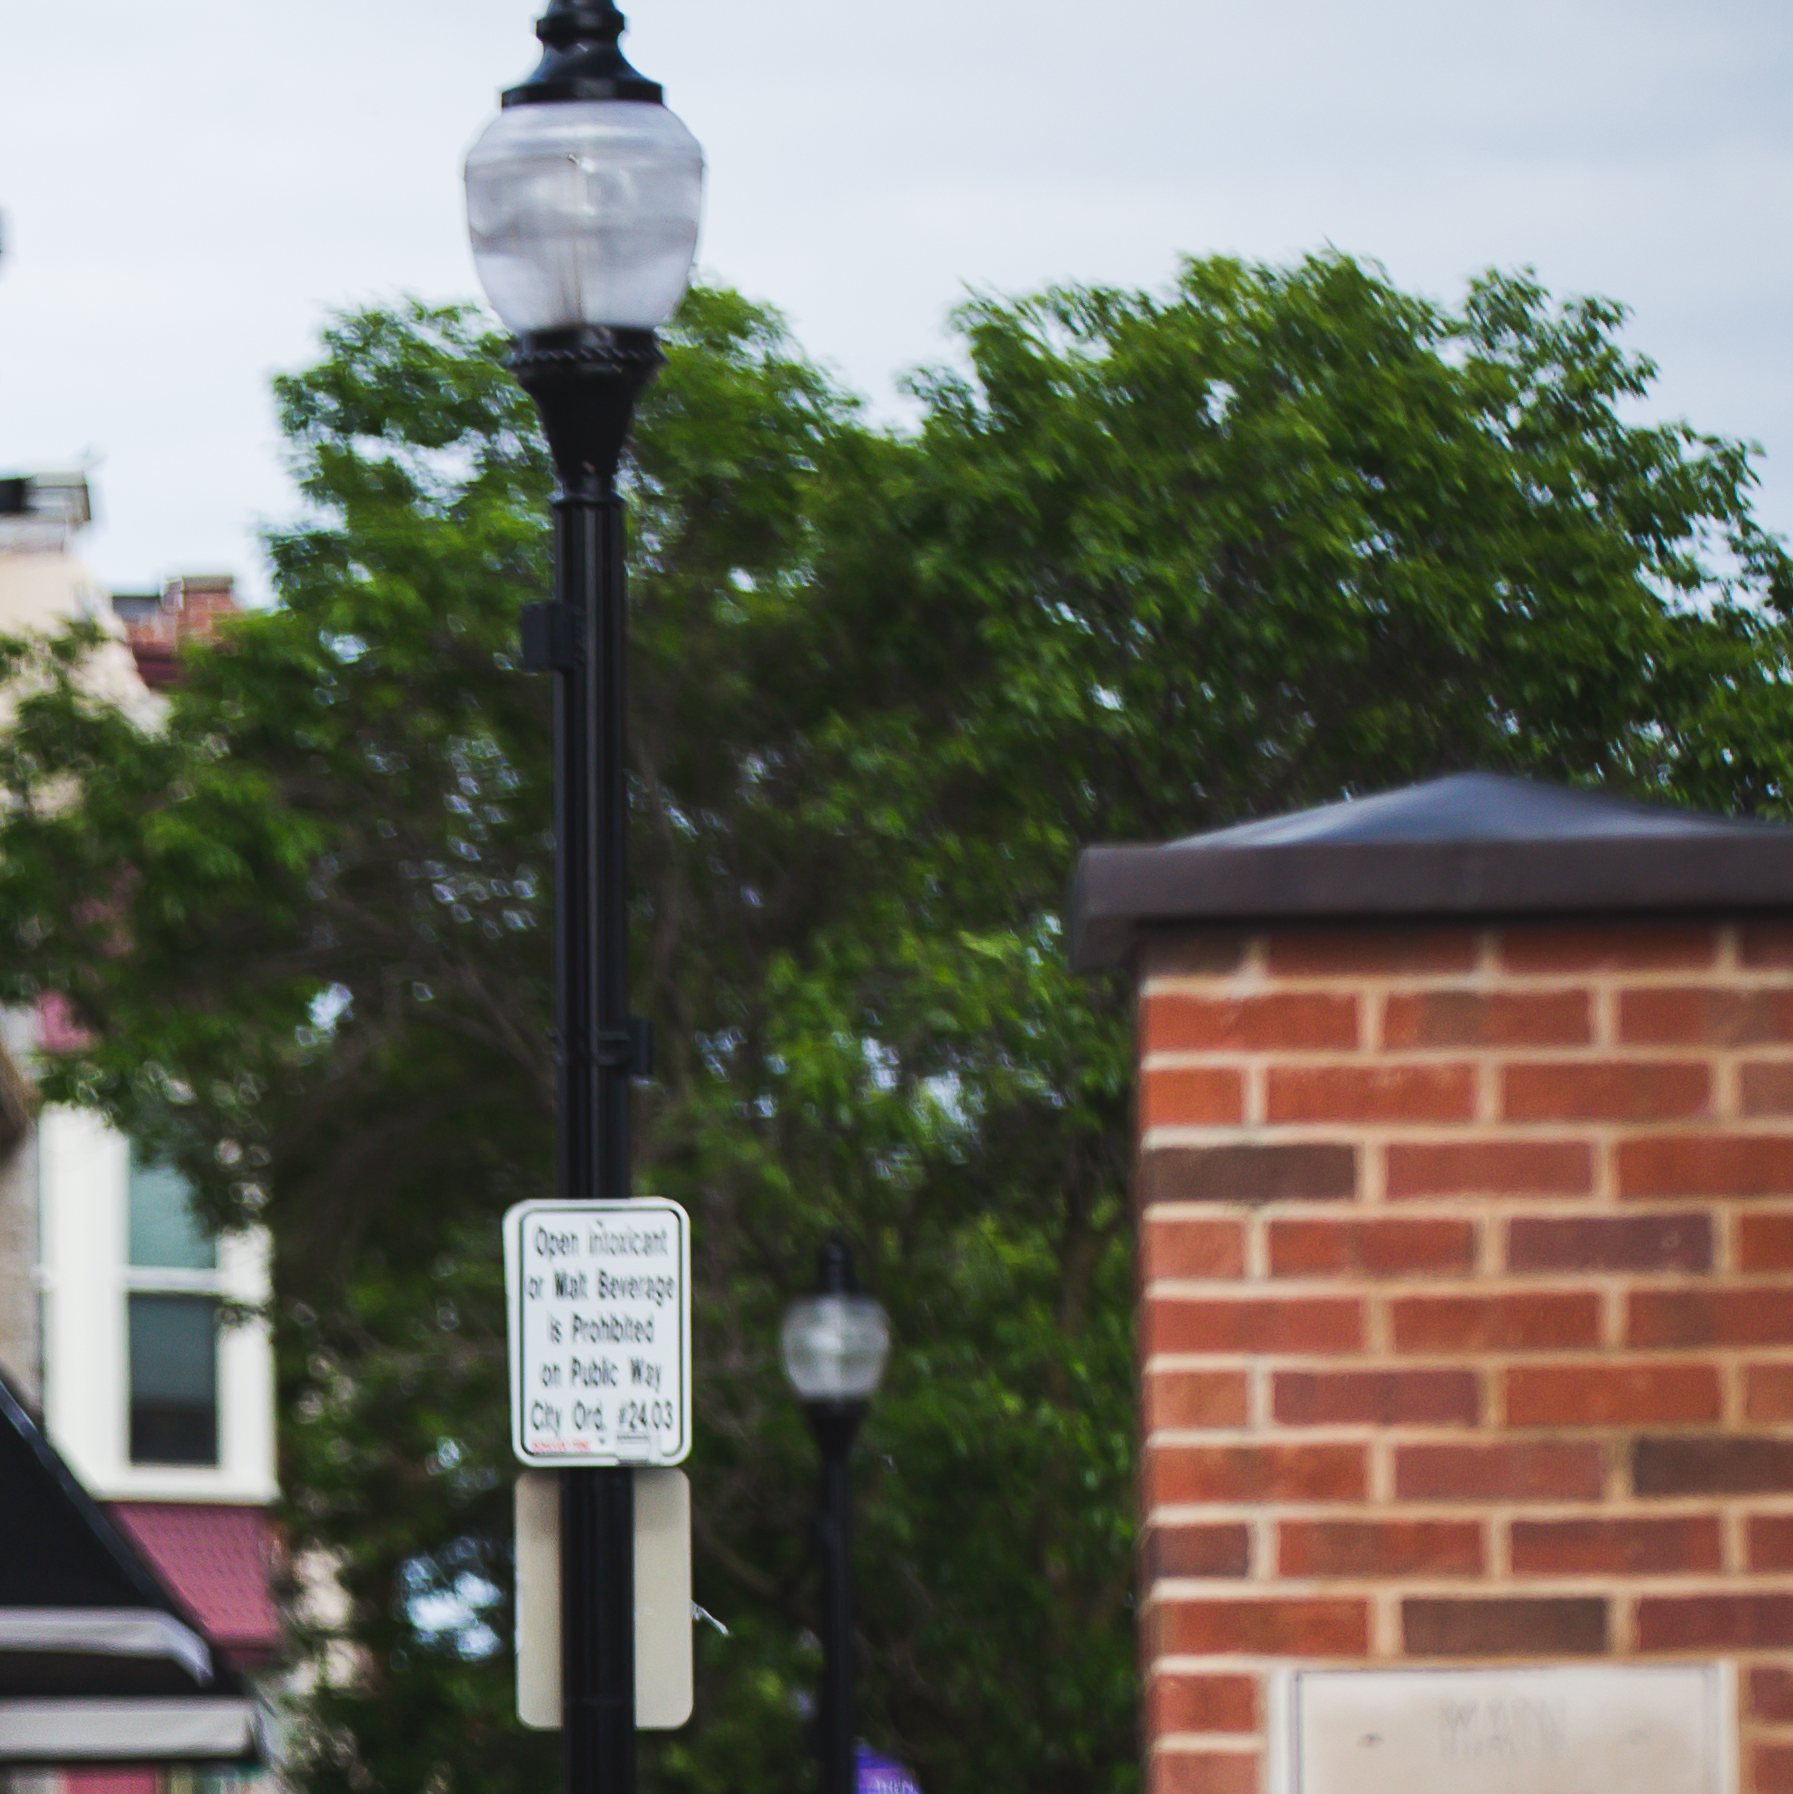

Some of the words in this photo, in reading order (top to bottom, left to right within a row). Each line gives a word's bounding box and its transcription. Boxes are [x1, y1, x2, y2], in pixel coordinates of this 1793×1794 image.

[535, 1226, 580, 1260] Open
[526, 1276, 545, 1299] or
[597, 1269, 675, 1307] Beverage
[572, 1313, 654, 1343] Prohibited
[541, 1362, 562, 1388] on
[571, 1356, 620, 1388] Public
[629, 1357, 662, 1394] Way
[530, 1401, 561, 1437] City
